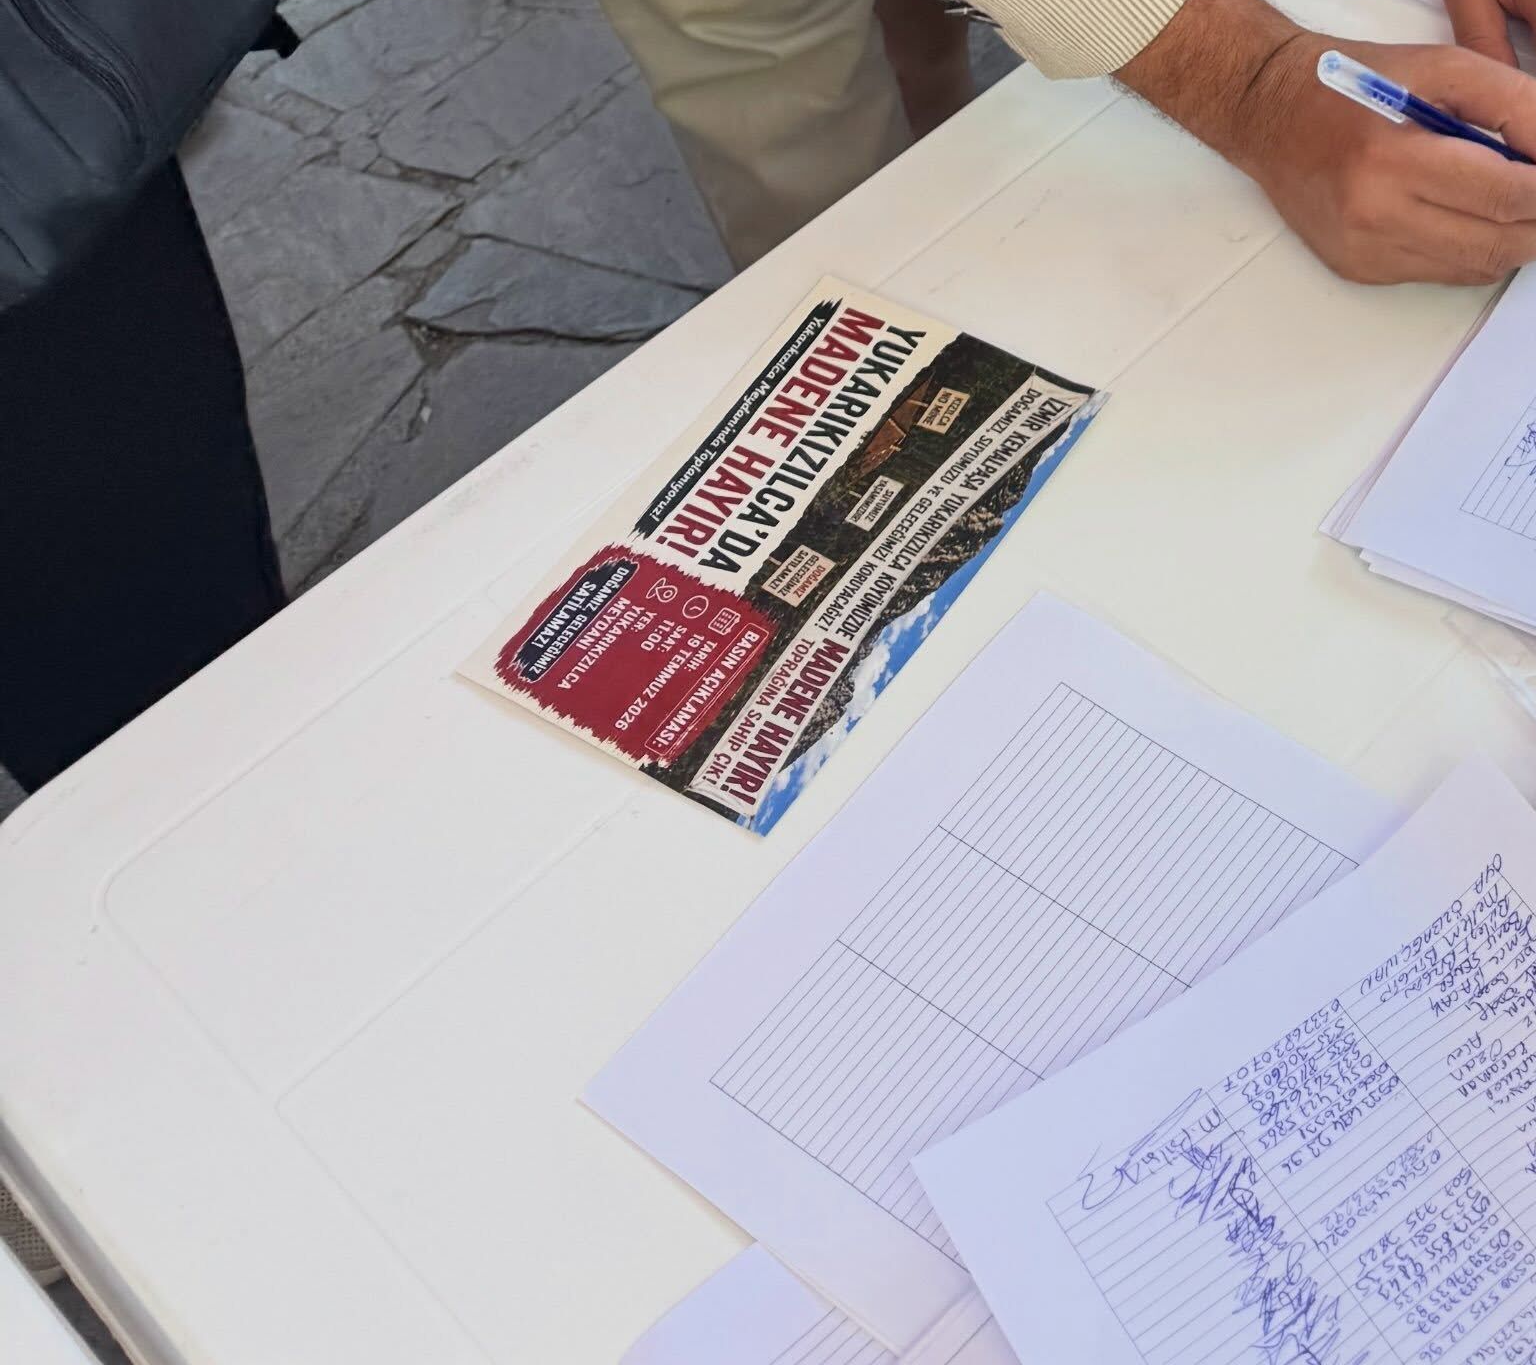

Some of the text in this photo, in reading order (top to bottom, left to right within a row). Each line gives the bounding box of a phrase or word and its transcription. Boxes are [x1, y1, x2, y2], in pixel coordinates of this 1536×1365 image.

[937, 390, 952, 405] NO
[654, 306, 886, 559] MADENE HAYIR!
[938, 434, 990, 485] SUYUMUZU
[647, 443, 717, 521] Toplanıyoruz!
[925, 483, 943, 498] VE
[871, 495, 932, 561] GELECEĞİMİZİ
[719, 395, 1071, 808] İZMİR KEMALPAŞA YUKARIKIZILCA KÖYÜMÜZDE MADENE HAYIR!
[792, 563, 826, 598] DOĞAMIZ
[813, 559, 877, 633] KORUYACAĞIZ!
[527, 612, 588, 676] GELECEĞİMİZ
[556, 603, 644, 690] YUKARIKIZILCA
[574, 596, 630, 651] MEYDANI
[629, 608, 658, 634] YER:
[639, 617, 675, 653] 11:00
[655, 623, 688, 654] SAAT:
[613, 631, 705, 732] 19 TEMMUZ 2026
[682, 638, 719, 675] TARİH:
[754, 636, 815, 709] TOPRAĞINA
[650, 628, 760, 749] BASIN AÇIKLAMASI:
[724, 707, 765, 754] SAHİP
[700, 749, 732, 785] ÇIK!
